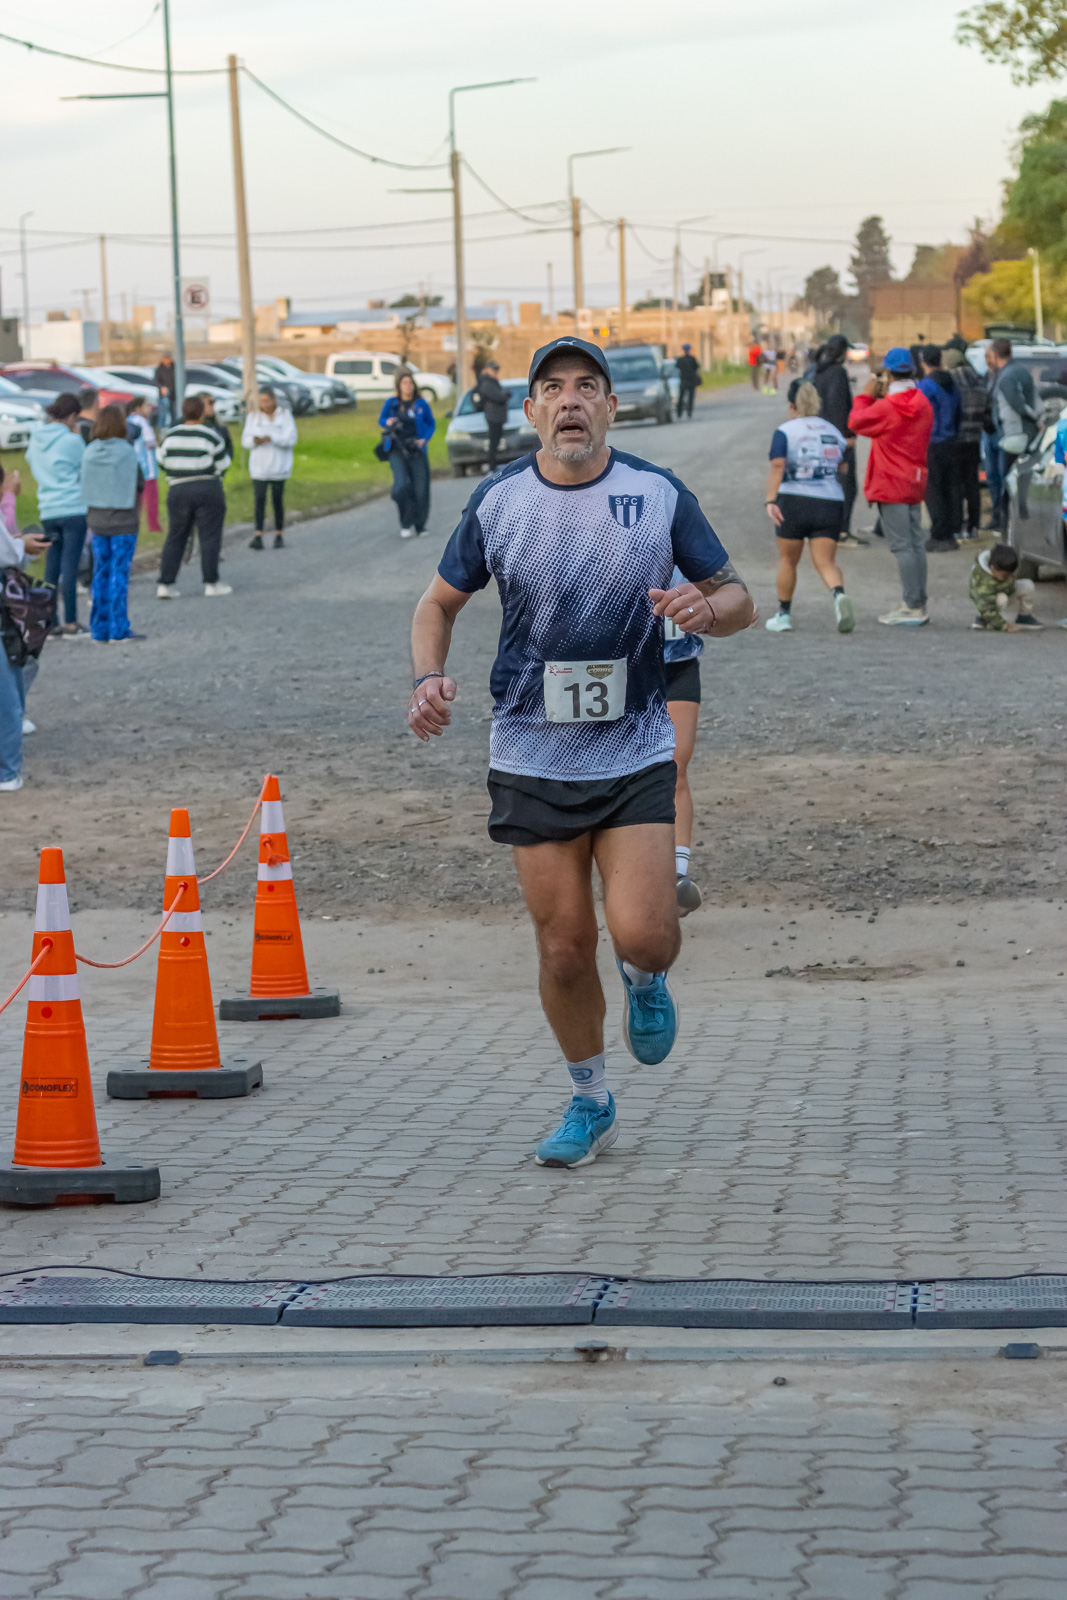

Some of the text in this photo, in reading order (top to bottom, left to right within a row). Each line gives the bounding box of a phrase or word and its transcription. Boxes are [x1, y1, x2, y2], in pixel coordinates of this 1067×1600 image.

[615, 497, 638, 505] SFC
[563, 681, 609, 719] 13
[29, 1084, 75, 1092] CONOFLEX
